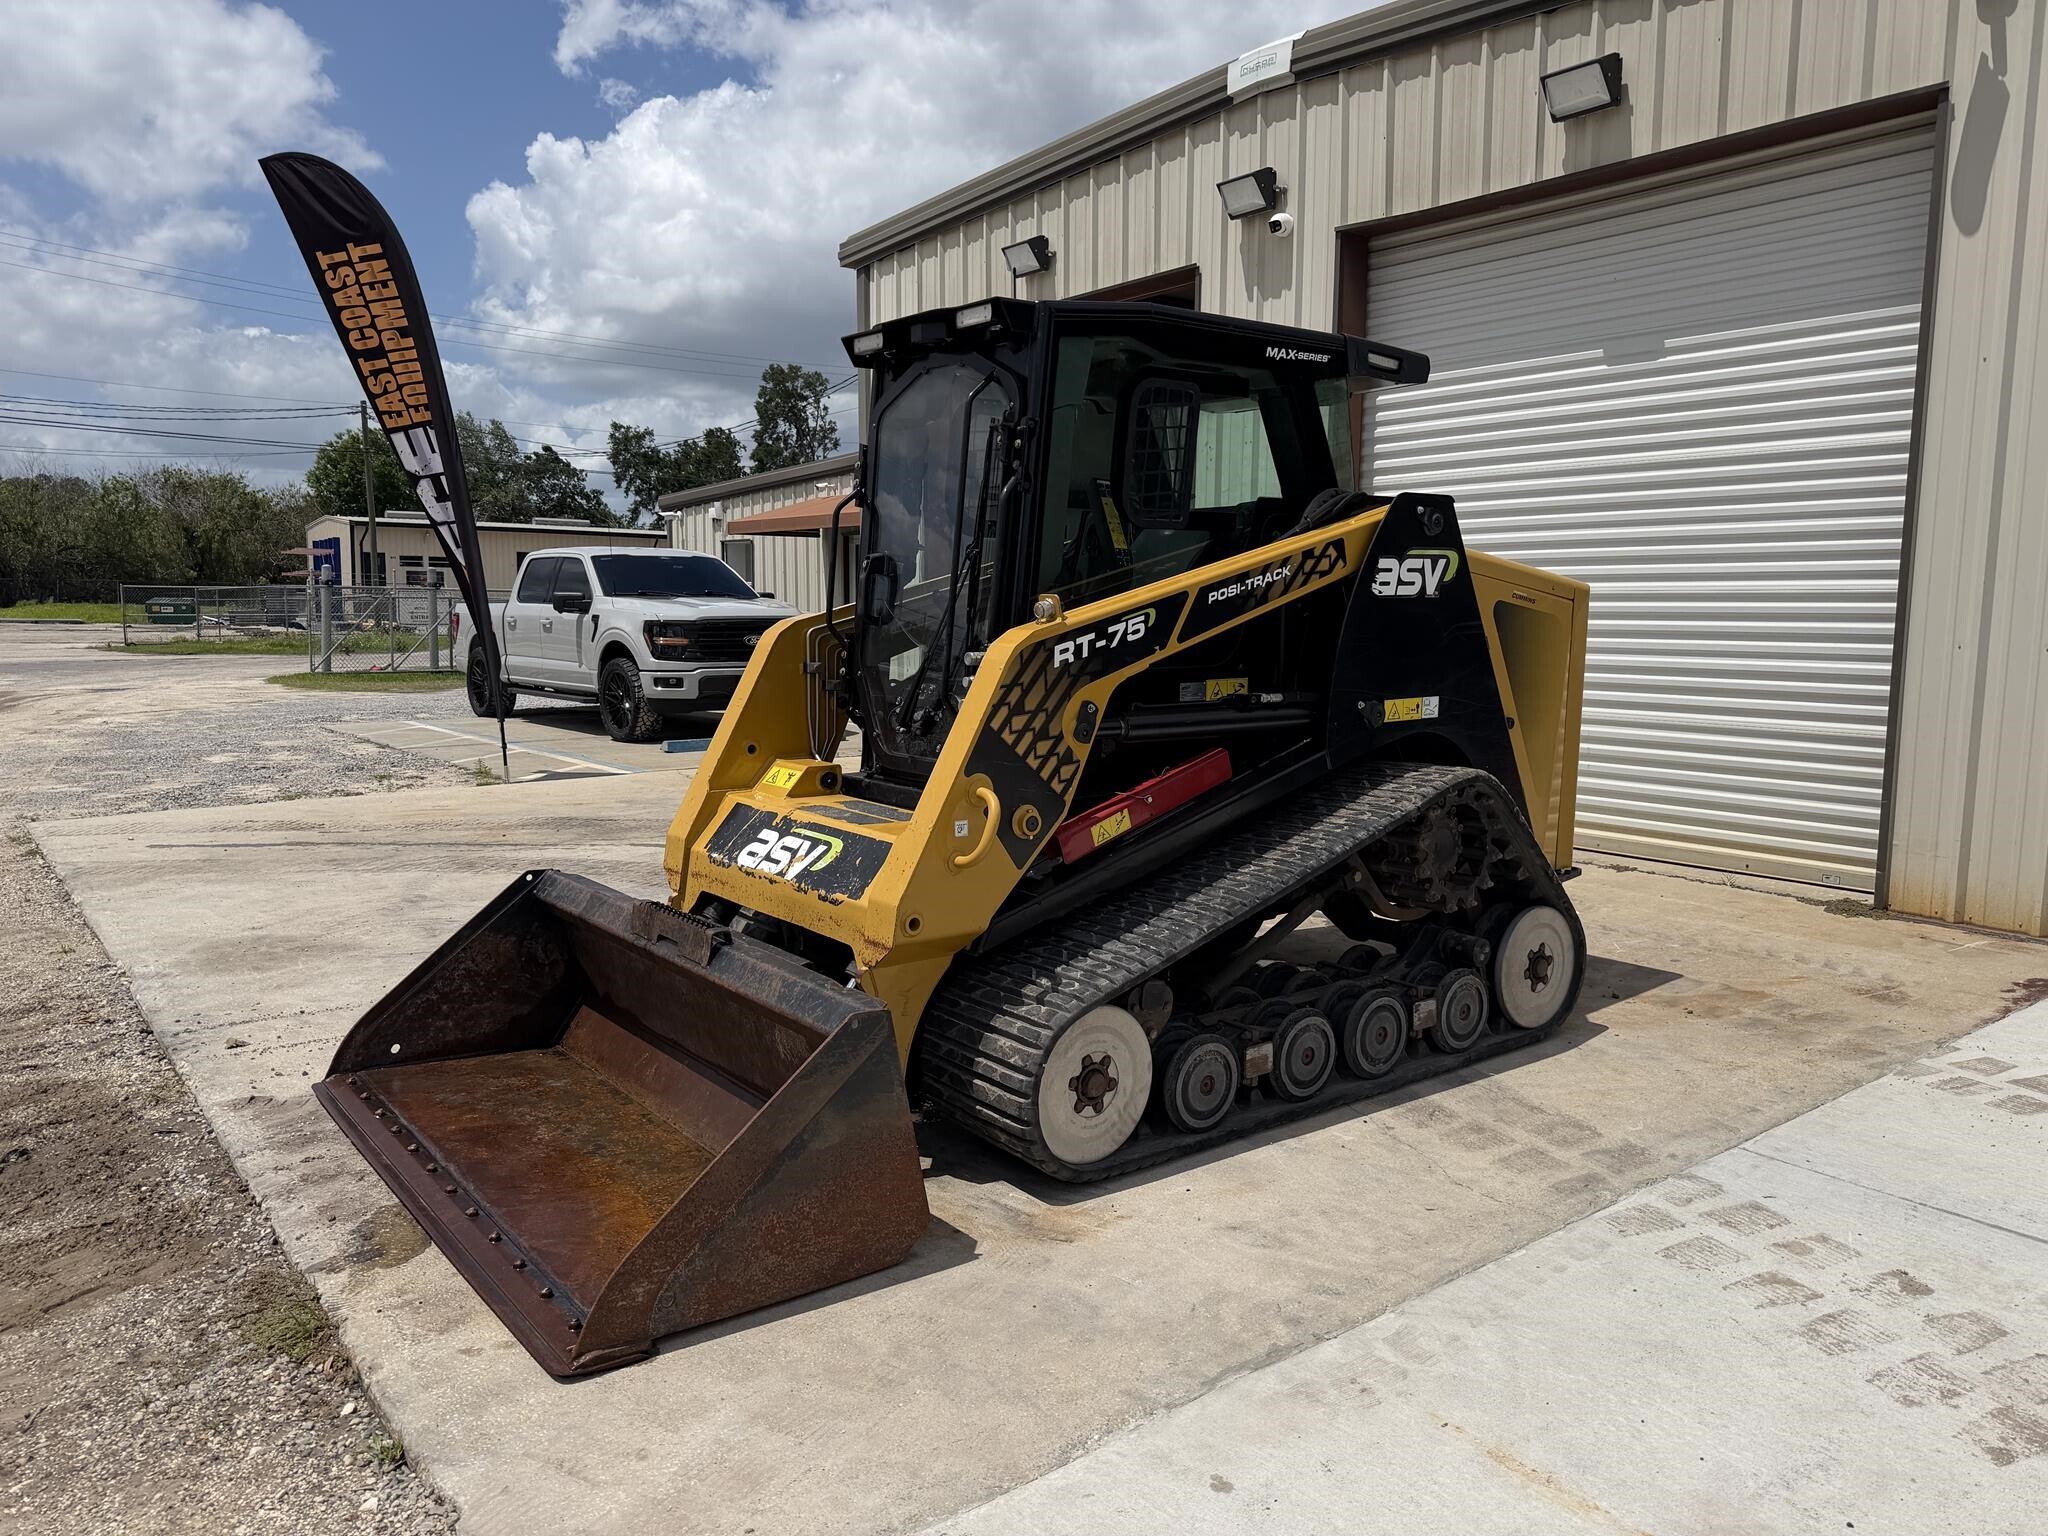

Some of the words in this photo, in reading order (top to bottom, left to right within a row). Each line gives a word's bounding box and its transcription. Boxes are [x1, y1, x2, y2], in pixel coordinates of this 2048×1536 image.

[315, 250, 380, 350] COAST
[347, 242, 433, 424] EQUIPMENT
[357, 357, 412, 429] EAST
[1208, 564, 1292, 605] POSI-TRACK
[1053, 614, 1146, 668] RT-75
